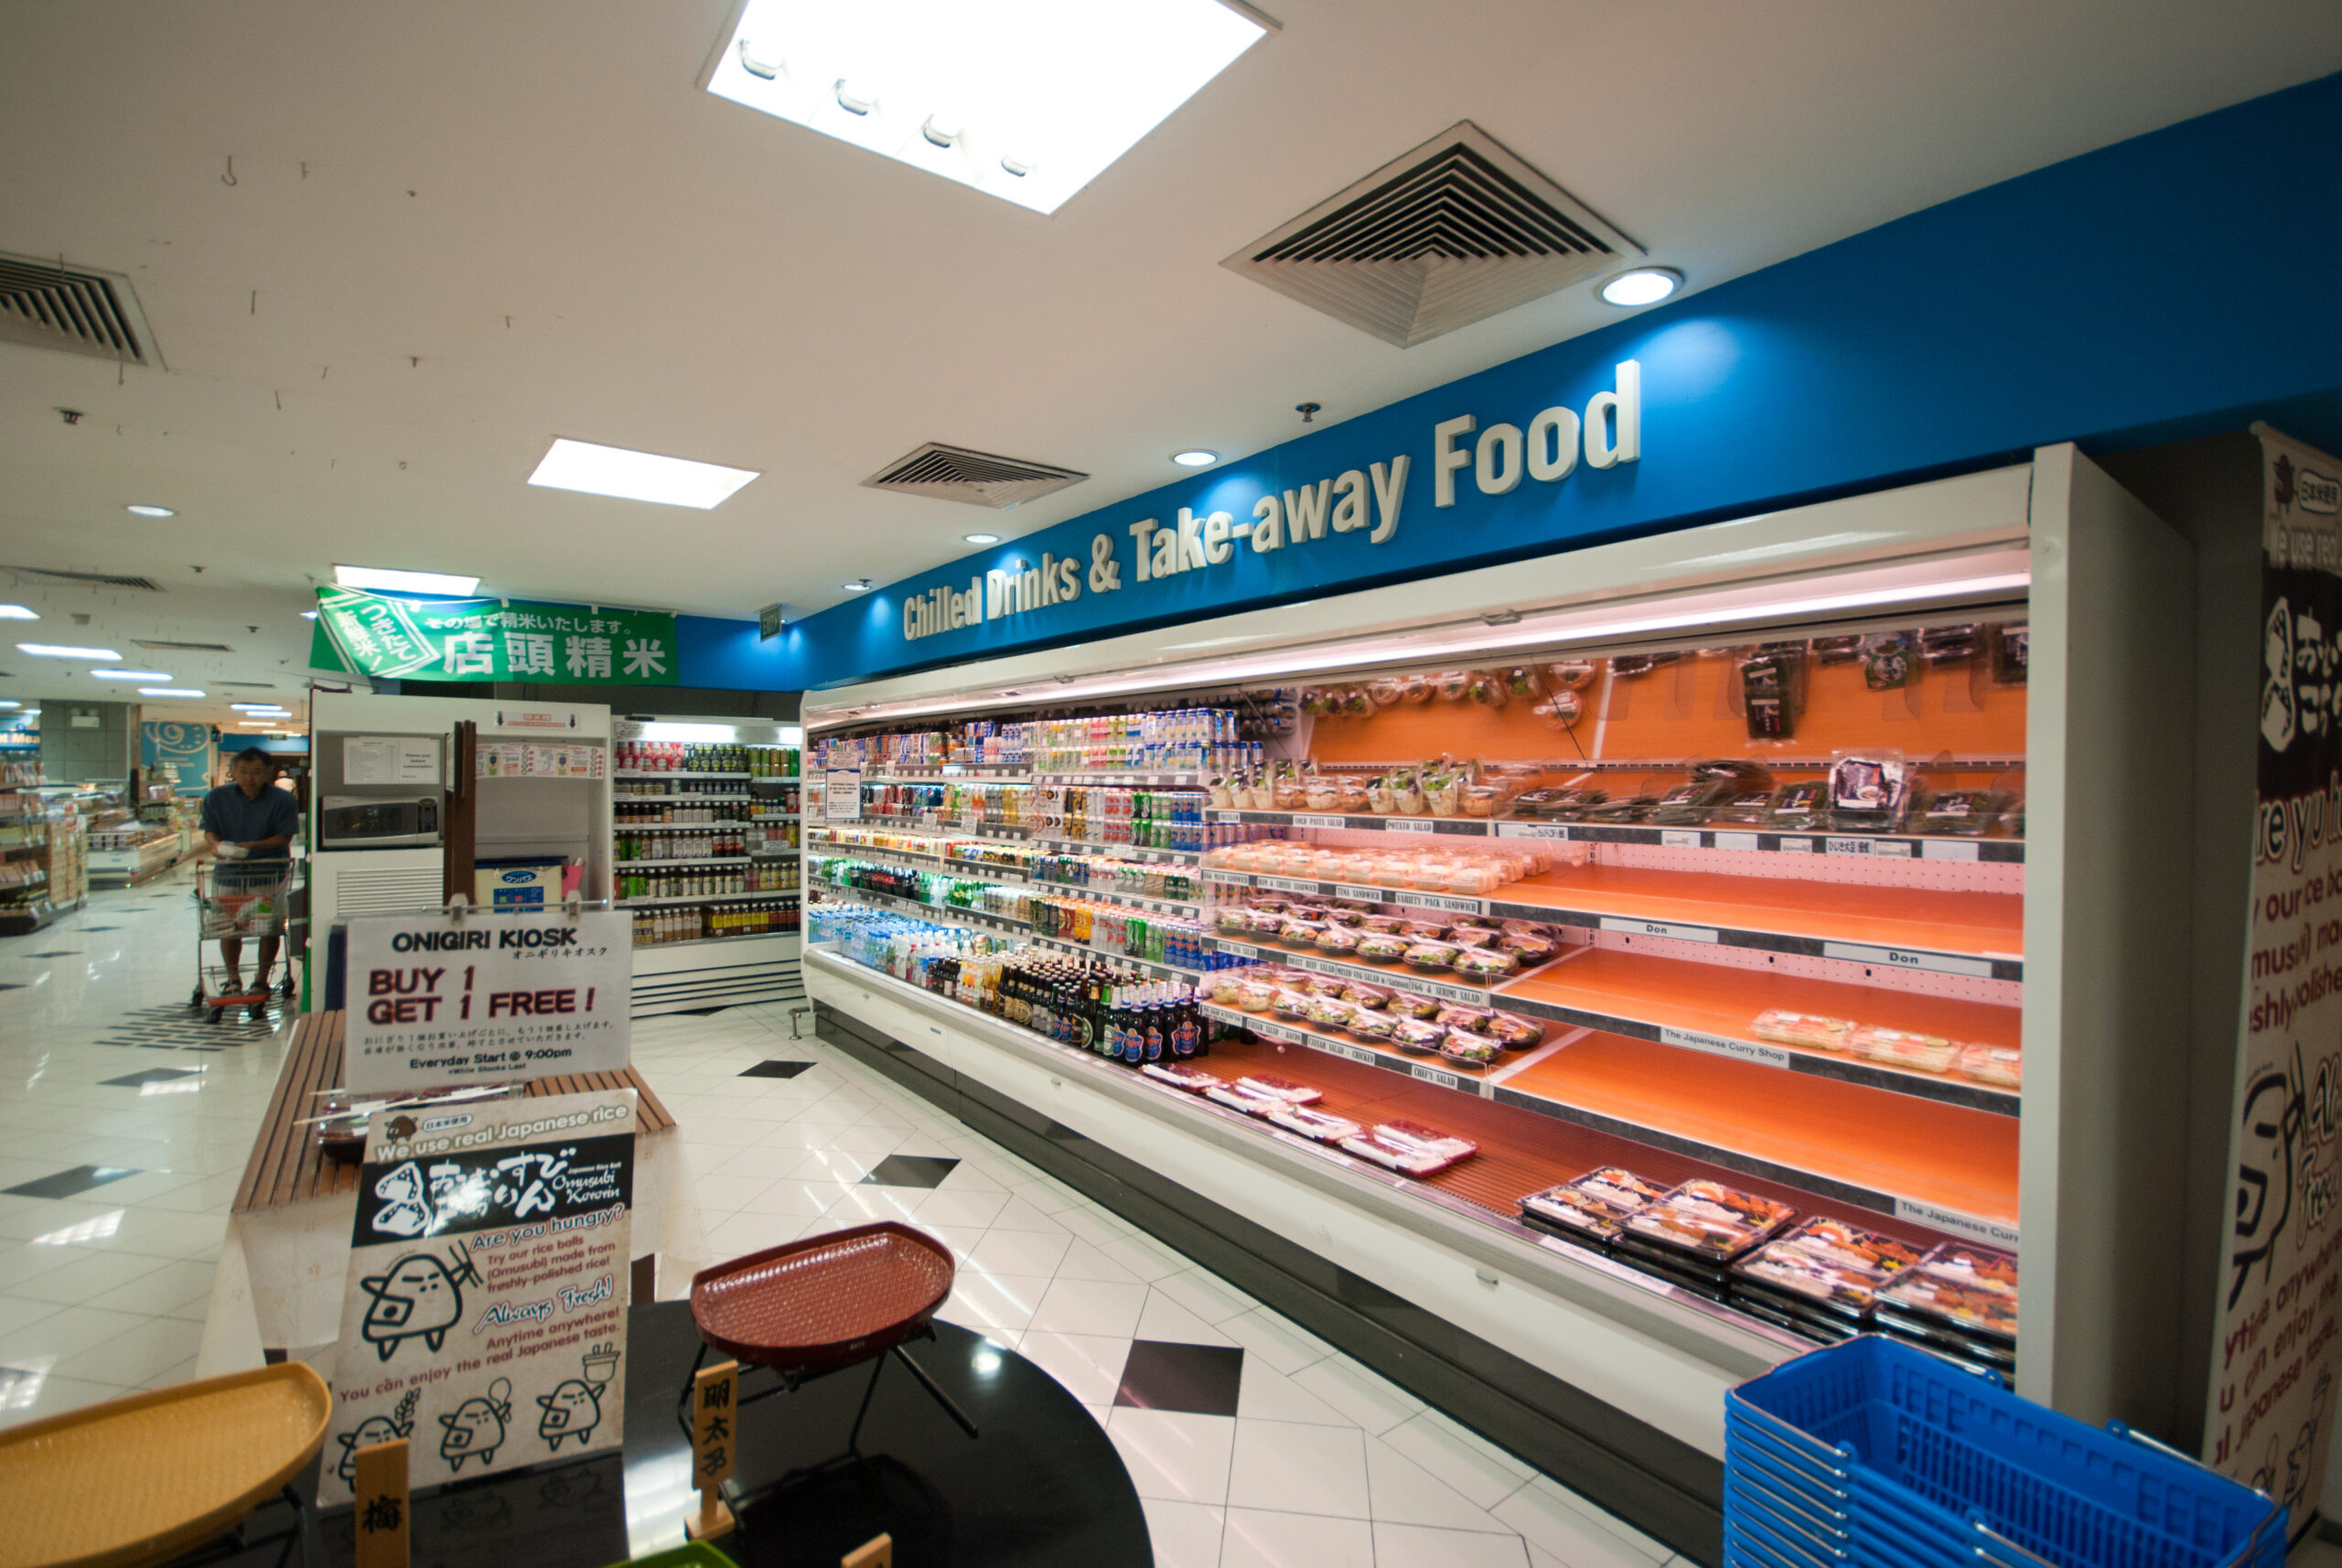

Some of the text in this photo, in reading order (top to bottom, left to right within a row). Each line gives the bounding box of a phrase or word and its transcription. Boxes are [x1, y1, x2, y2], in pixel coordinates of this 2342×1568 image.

[903, 359, 1641, 640] Chilled Drinks & Take-away Food
[443, 631, 667, 678] 店頭精米
[1387, 822, 1432, 832] POTATO SALAD
[1353, 889, 1380, 901] SANDWICH
[1397, 894, 1477, 912] VARIETY PACK SANDWICH
[392, 927, 577, 952] ONIGIRI KIOSK
[1646, 925, 1668, 935] Don
[512, 947, 607, 960] オニギリキオスク
[1320, 963, 1335, 973] SALAD
[1889, 951, 1918, 964] Don
[369, 965, 475, 996] BUY 1
[1364, 972, 1380, 983] SALAD
[367, 996, 443, 1025] GET
[459, 994, 471, 1019] 1
[488, 989, 576, 1017] FREE
[1460, 992, 1479, 1004] SALAD
[410, 1048, 572, 1069] Everyday Start @ 9:00pm
[1665, 1029, 1785, 1061] The Japanese Curry Shop
[1414, 1068, 1456, 1087] CHEF'S SALAD
[376, 1104, 628, 1163] We use real Japanese rice
[553, 1170, 616, 1190] Omusubi
[566, 1187, 620, 1204] Kororin
[471, 1203, 625, 1252] Are you hungry?
[1902, 1201, 1924, 1215] The
[1927, 1209, 1987, 1234] Japanese
[488, 1237, 584, 1266] Try our rice balls
[488, 1242, 616, 1280] (Omusubi) made from
[488, 1256, 610, 1293] freshly-polished rice!
[474, 1275, 612, 1334] Always Fresh!
[487, 1306, 619, 1349] Anytime anywhere!
[340, 1323, 619, 1402] You can enjoy the real Japanese taste.
[701, 1378, 730, 1477] 明太子
[361, 1494, 403, 1534] 梅
